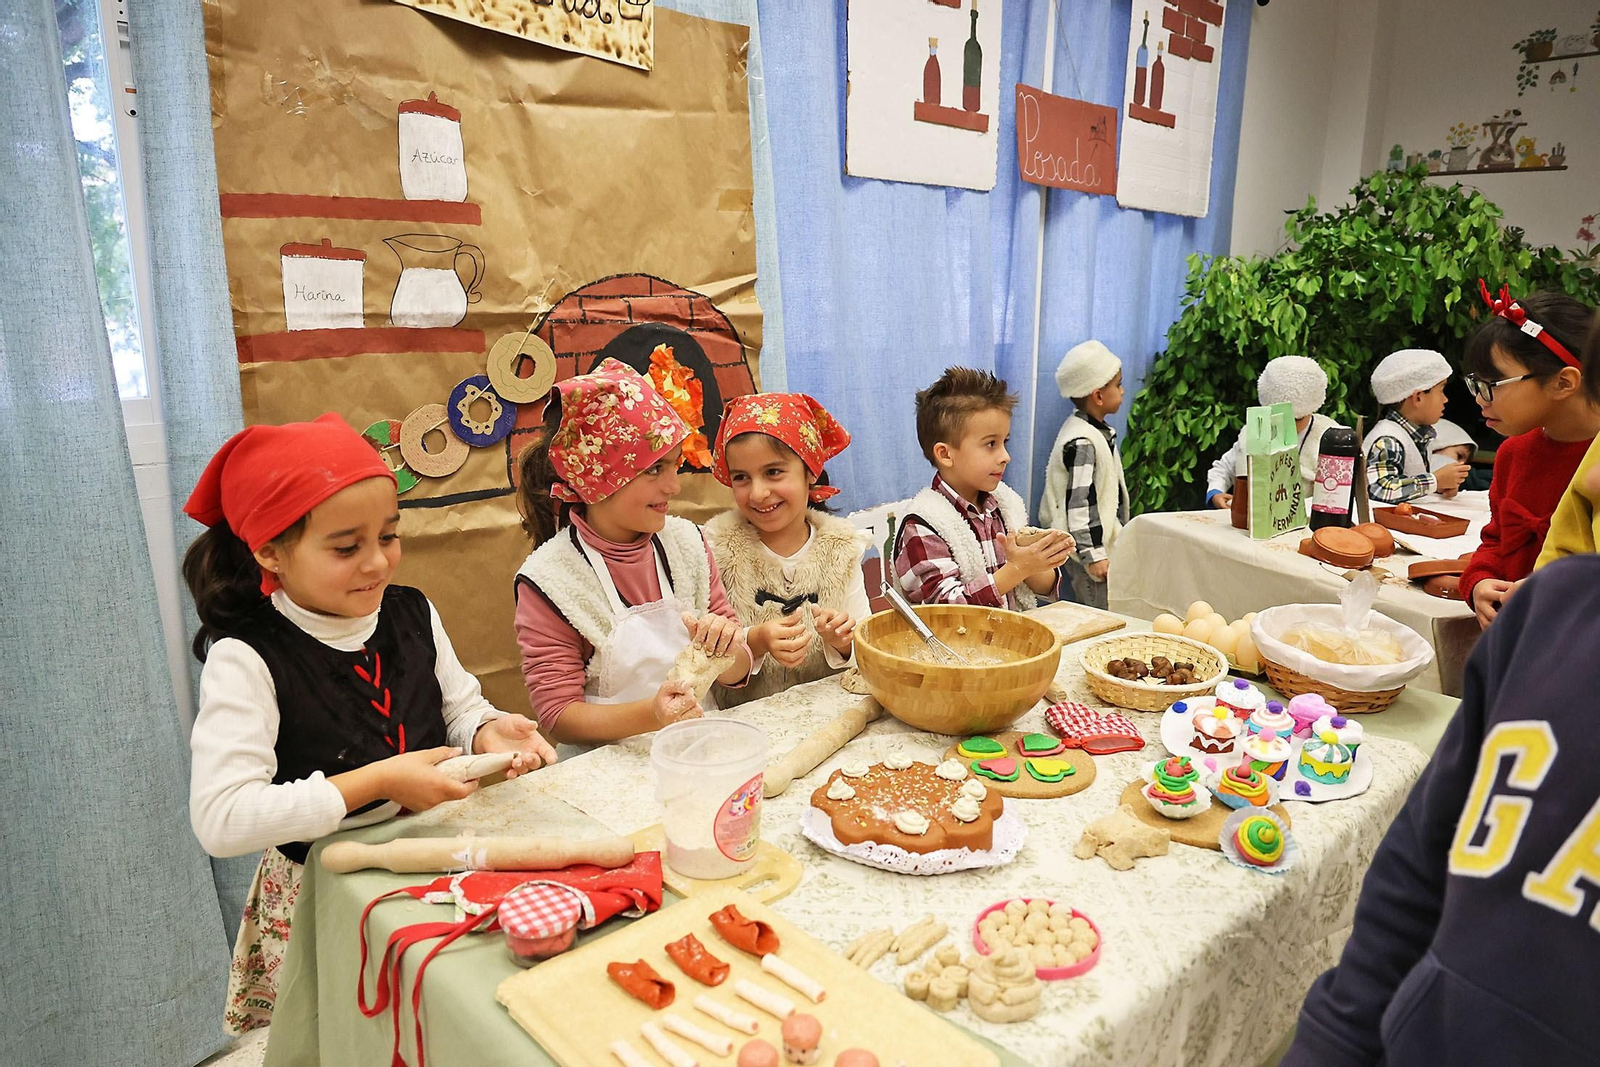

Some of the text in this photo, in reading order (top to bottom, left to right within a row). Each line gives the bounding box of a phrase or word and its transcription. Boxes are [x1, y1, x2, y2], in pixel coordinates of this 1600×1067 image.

[1019, 92, 1101, 187] Posada
[411, 149, 459, 165] Azúcar
[294, 284, 345, 302] Harina
[1270, 453, 1295, 482] DEHESA
[1272, 482, 1301, 531] HERMANAS
